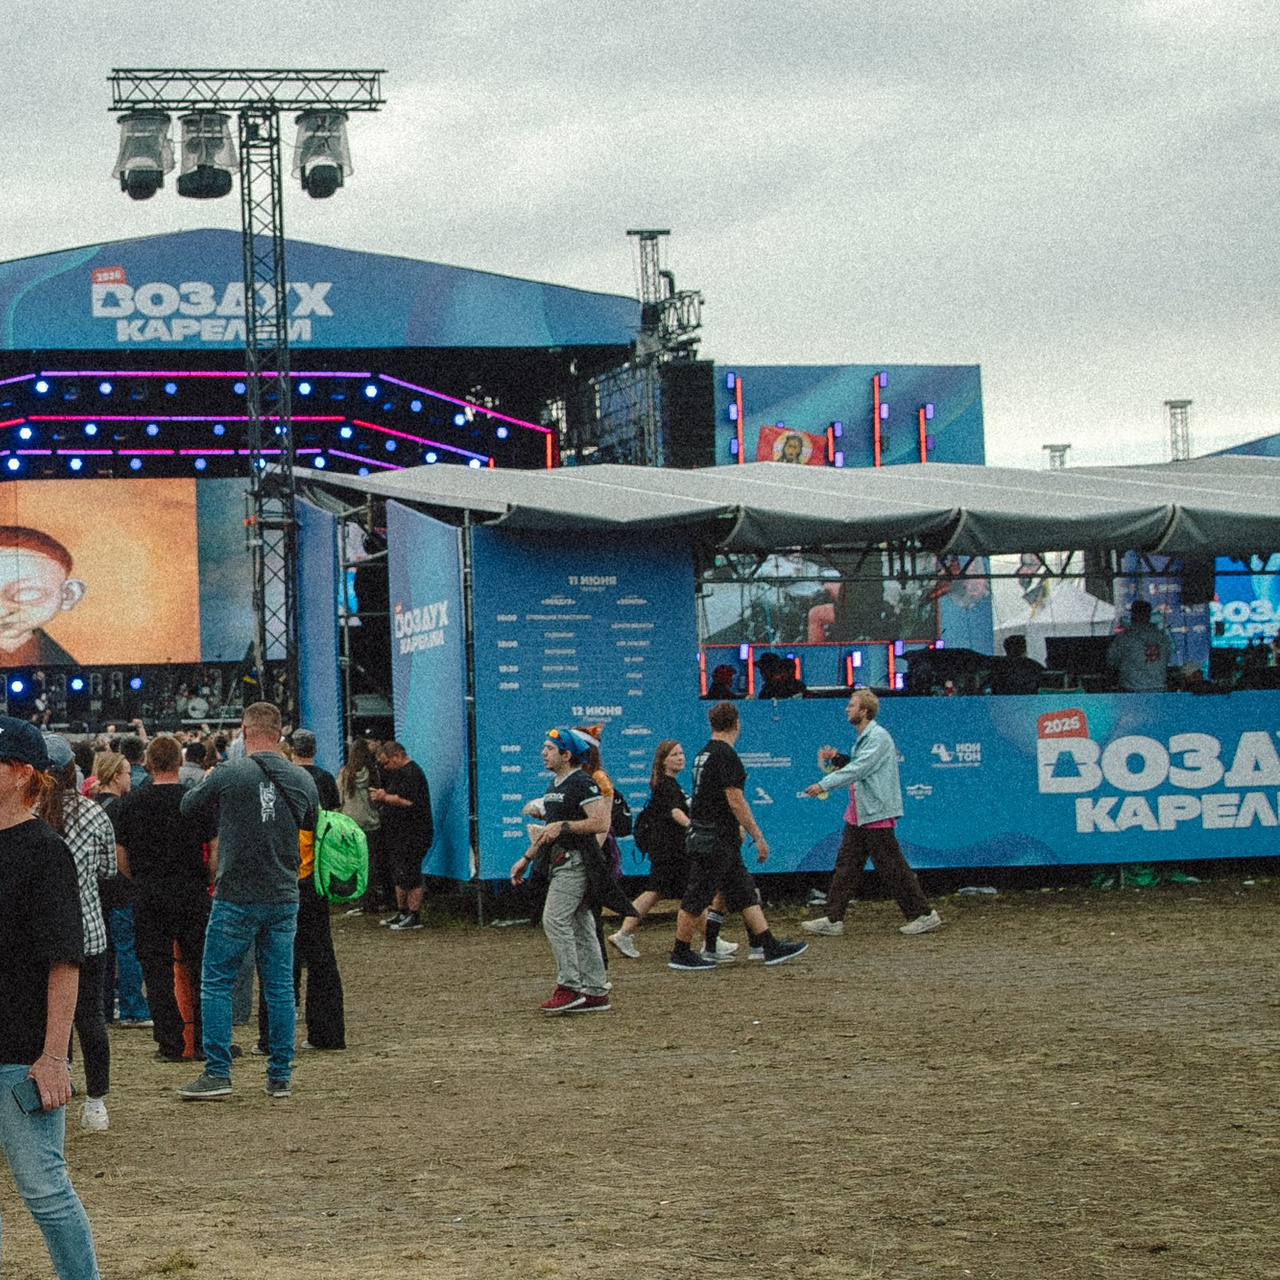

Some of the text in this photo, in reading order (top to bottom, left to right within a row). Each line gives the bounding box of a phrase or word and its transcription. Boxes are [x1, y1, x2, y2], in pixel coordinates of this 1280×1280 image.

[580, 575, 617, 586] ИЮНЯ
[572, 705, 623, 716] 12 ИЮНЯ
[1036, 731, 1280, 794] ВОЗД
[1075, 791, 1280, 833] КАРЕЛ
